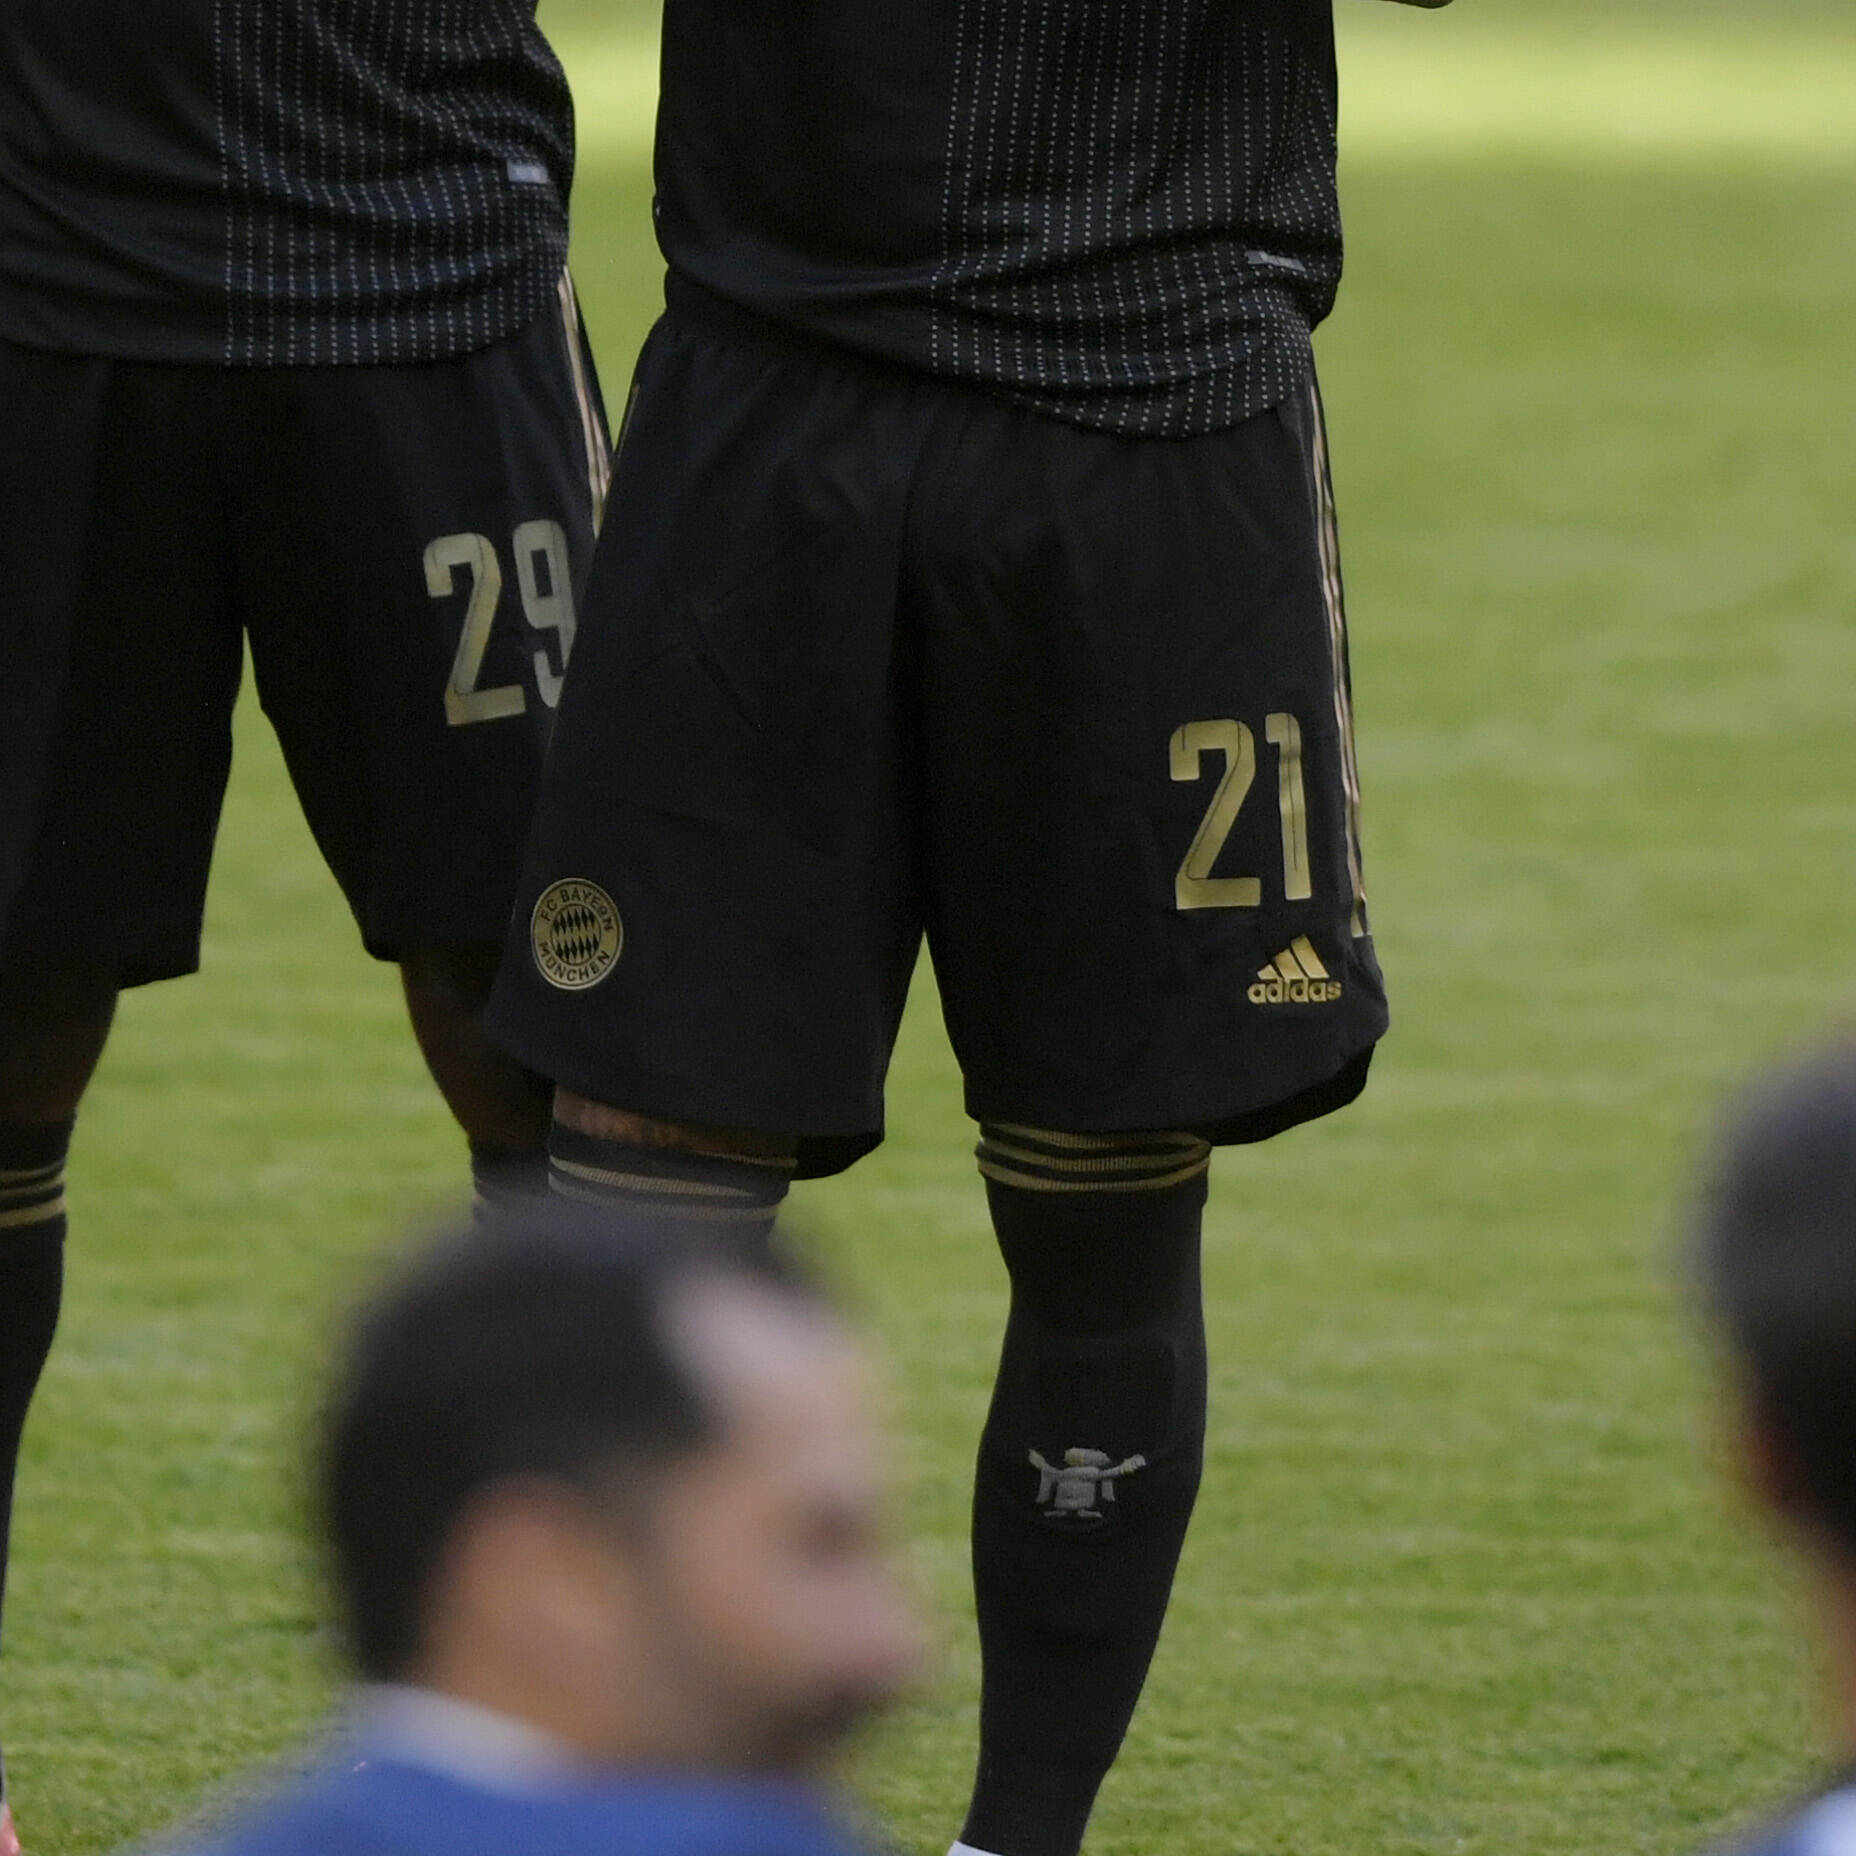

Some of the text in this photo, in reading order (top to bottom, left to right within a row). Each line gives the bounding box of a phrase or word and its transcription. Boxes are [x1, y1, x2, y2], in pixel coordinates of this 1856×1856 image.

[422, 519, 578, 727] 29
[1169, 712, 1312, 911] 21
[540, 887, 614, 931] FC BAYERN
[1247, 977, 1342, 1004] adidas
